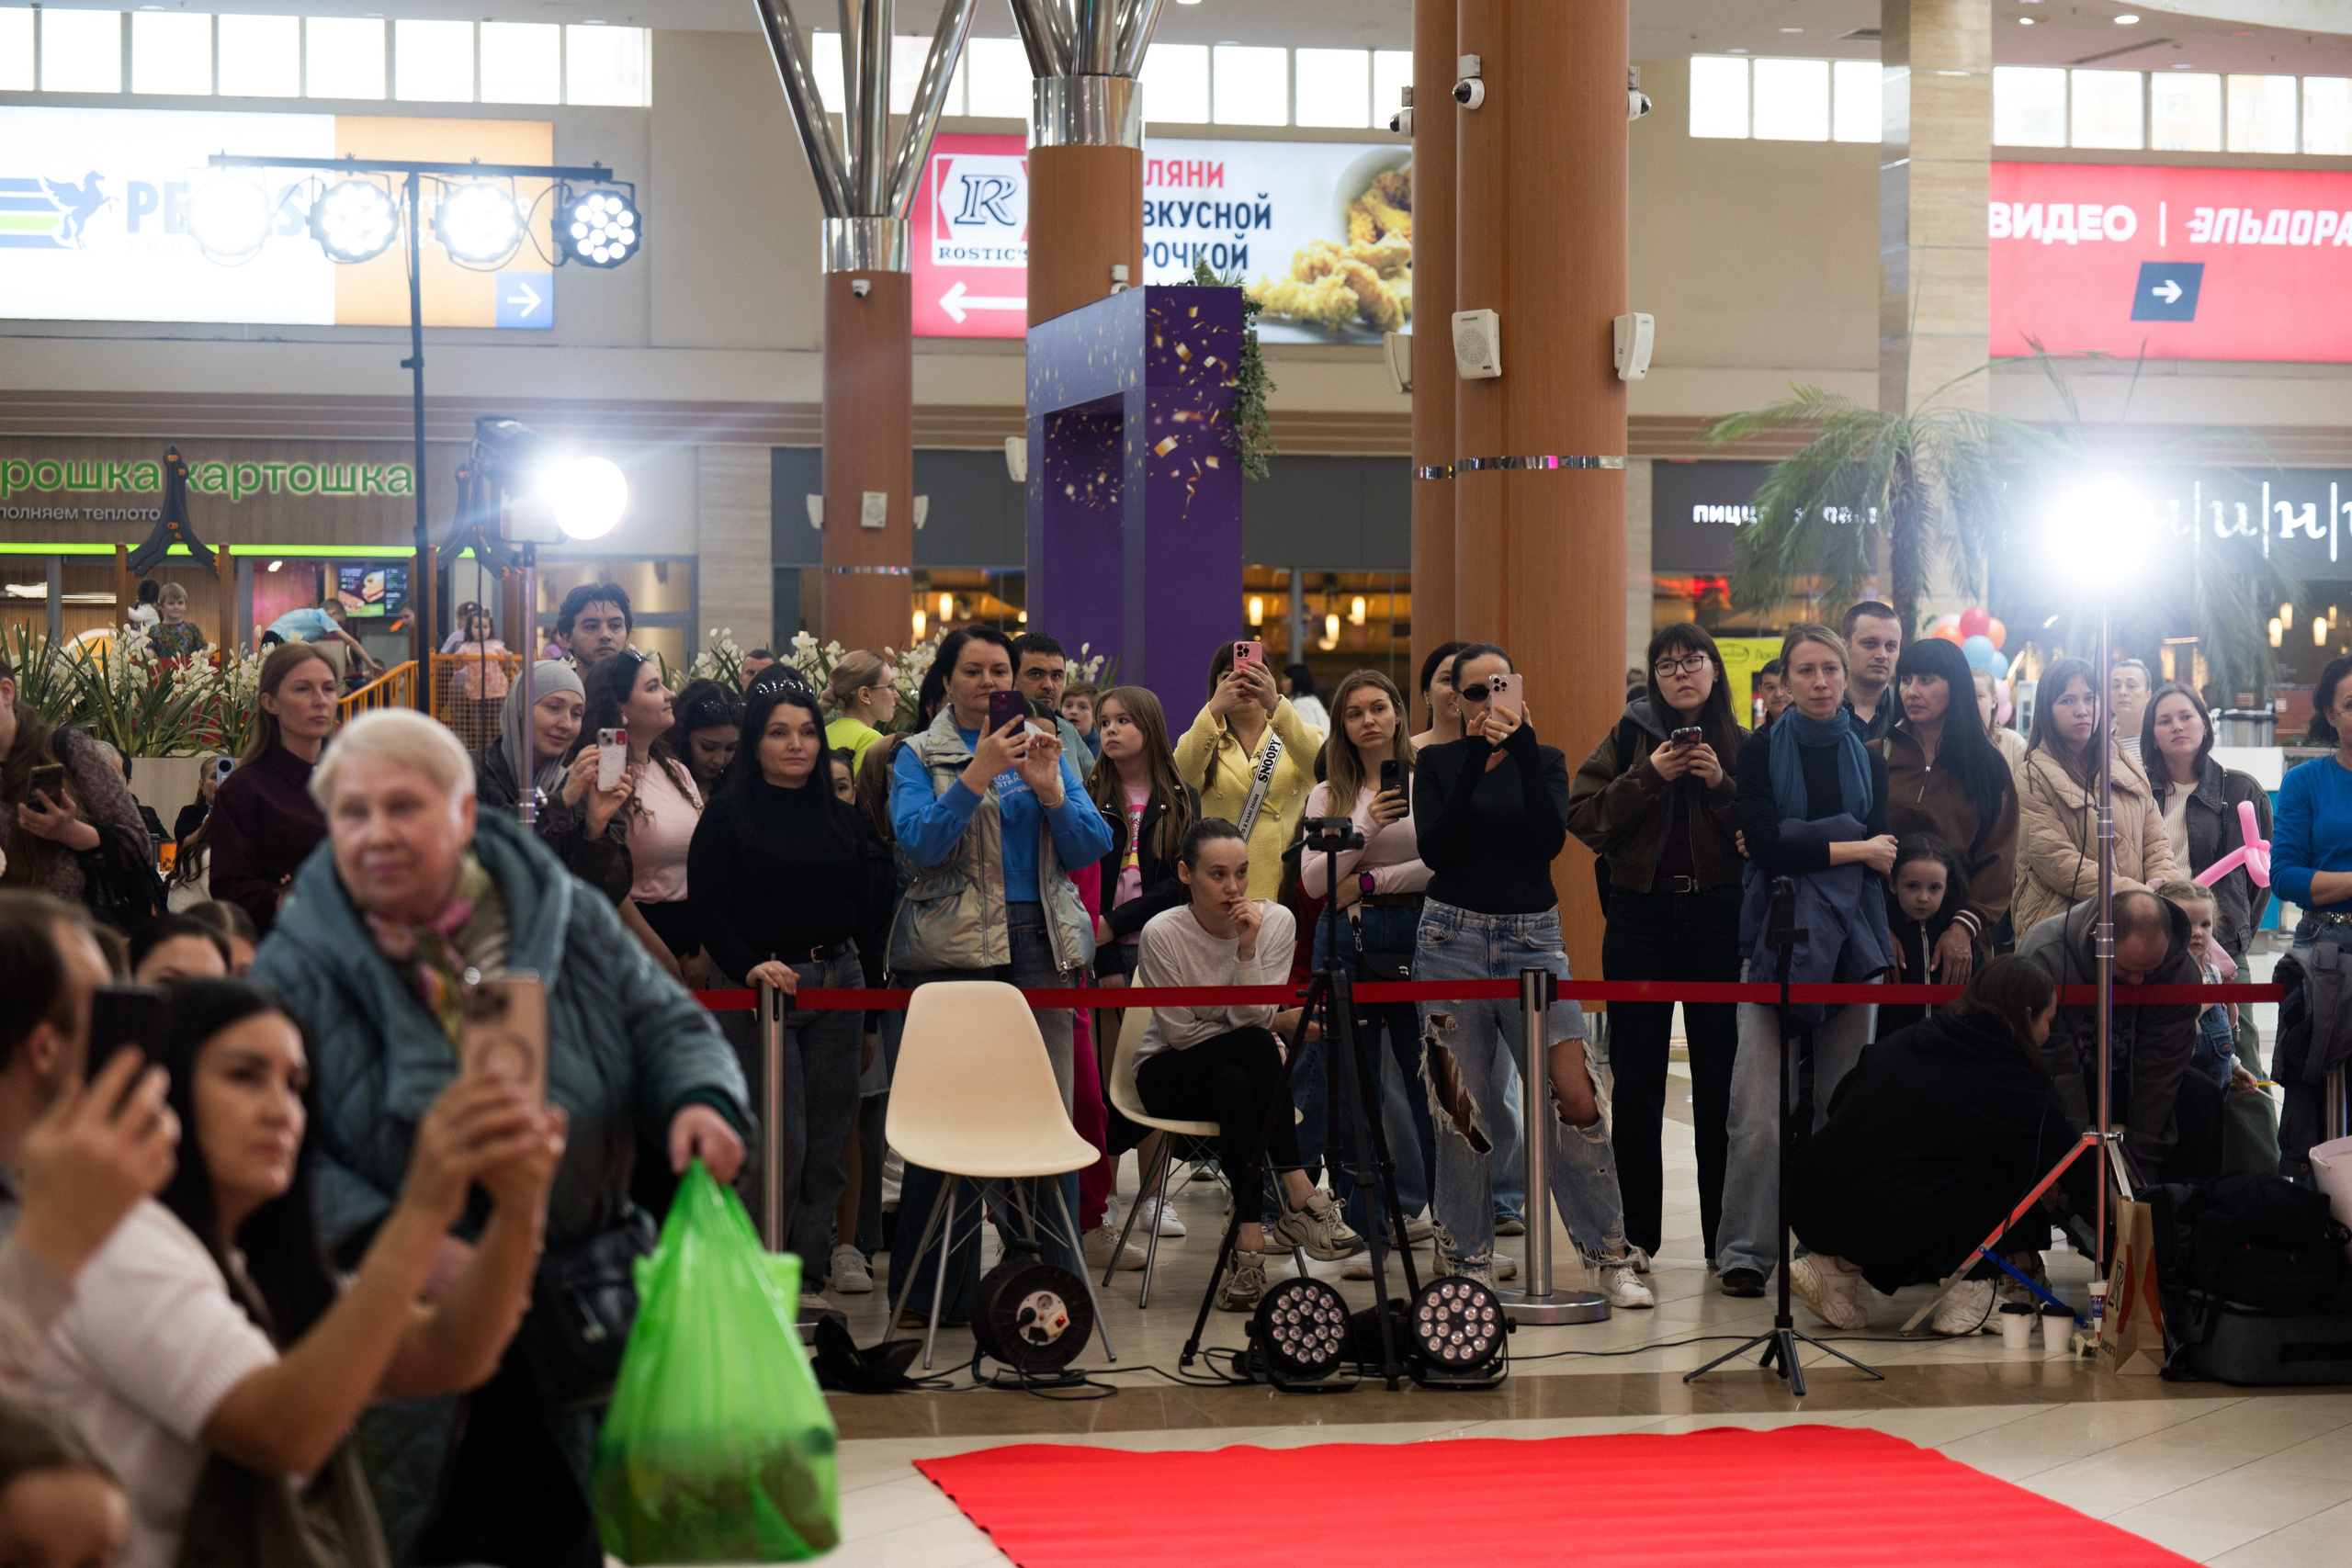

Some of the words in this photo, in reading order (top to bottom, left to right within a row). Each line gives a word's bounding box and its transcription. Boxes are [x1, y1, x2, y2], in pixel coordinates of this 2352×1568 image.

[1143, 192, 1272, 230] ВКУСНОЙ
[1989, 201, 2138, 245] ВИДЕО
[0, 459, 162, 499] рошка
[1257, 739, 1282, 784] SNOOPY
